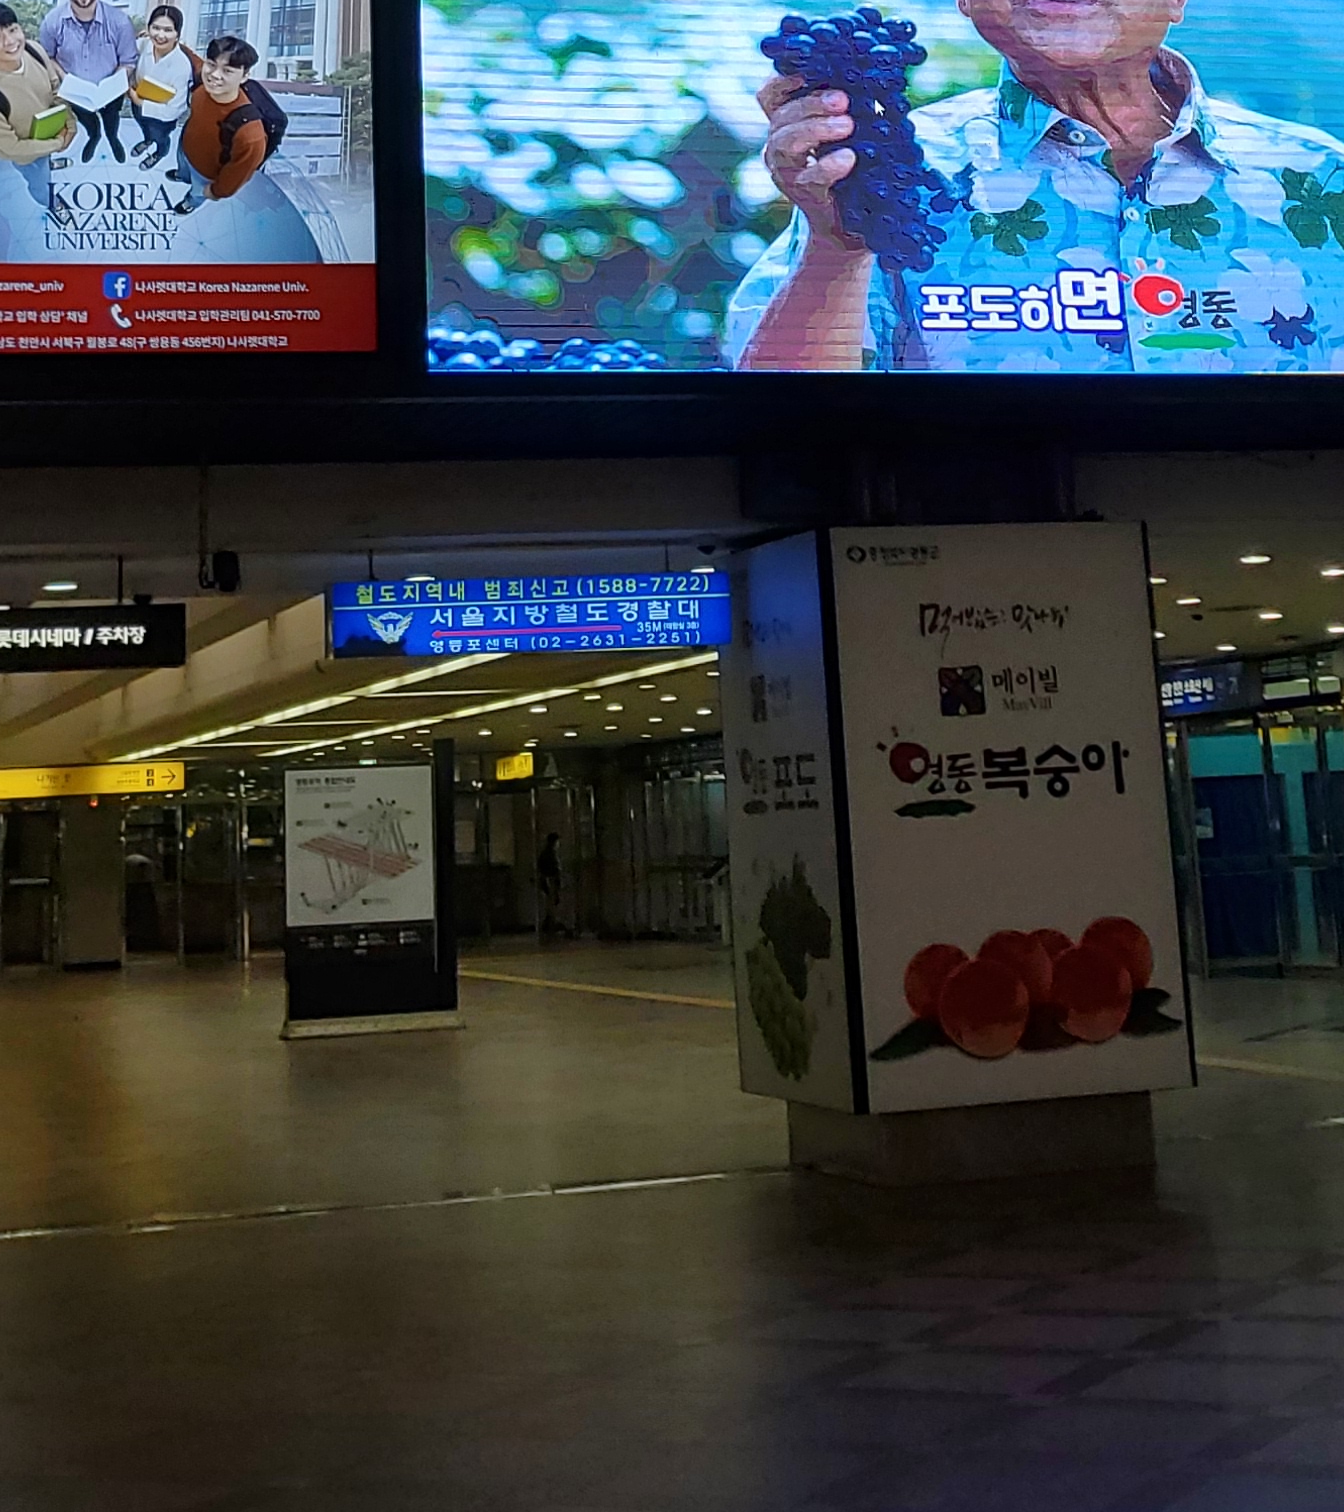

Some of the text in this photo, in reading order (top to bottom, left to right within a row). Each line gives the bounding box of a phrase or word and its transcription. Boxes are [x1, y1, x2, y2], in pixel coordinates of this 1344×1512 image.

[47, 182, 175, 211] KOREA
[44, 212, 177, 231] NAZARENE
[44, 233, 177, 250] UNIVERSITY
[199, 281, 229, 293] Korea
[231, 281, 280, 293] Nazarene
[282, 281, 310, 292] Univ.
[919, 268, 1125, 334] 포도하면
[252, 309, 320, 322] 041-570-7700
[356, 580, 466, 605] 철도지역내
[429, 599, 700, 628] 서울지방철도경찰대
[95, 626, 147, 646] 주차장
[637, 621, 661, 633] 35M
[429, 635, 519, 654] 영등포센터
[991, 665, 1059, 694] 메이빌
